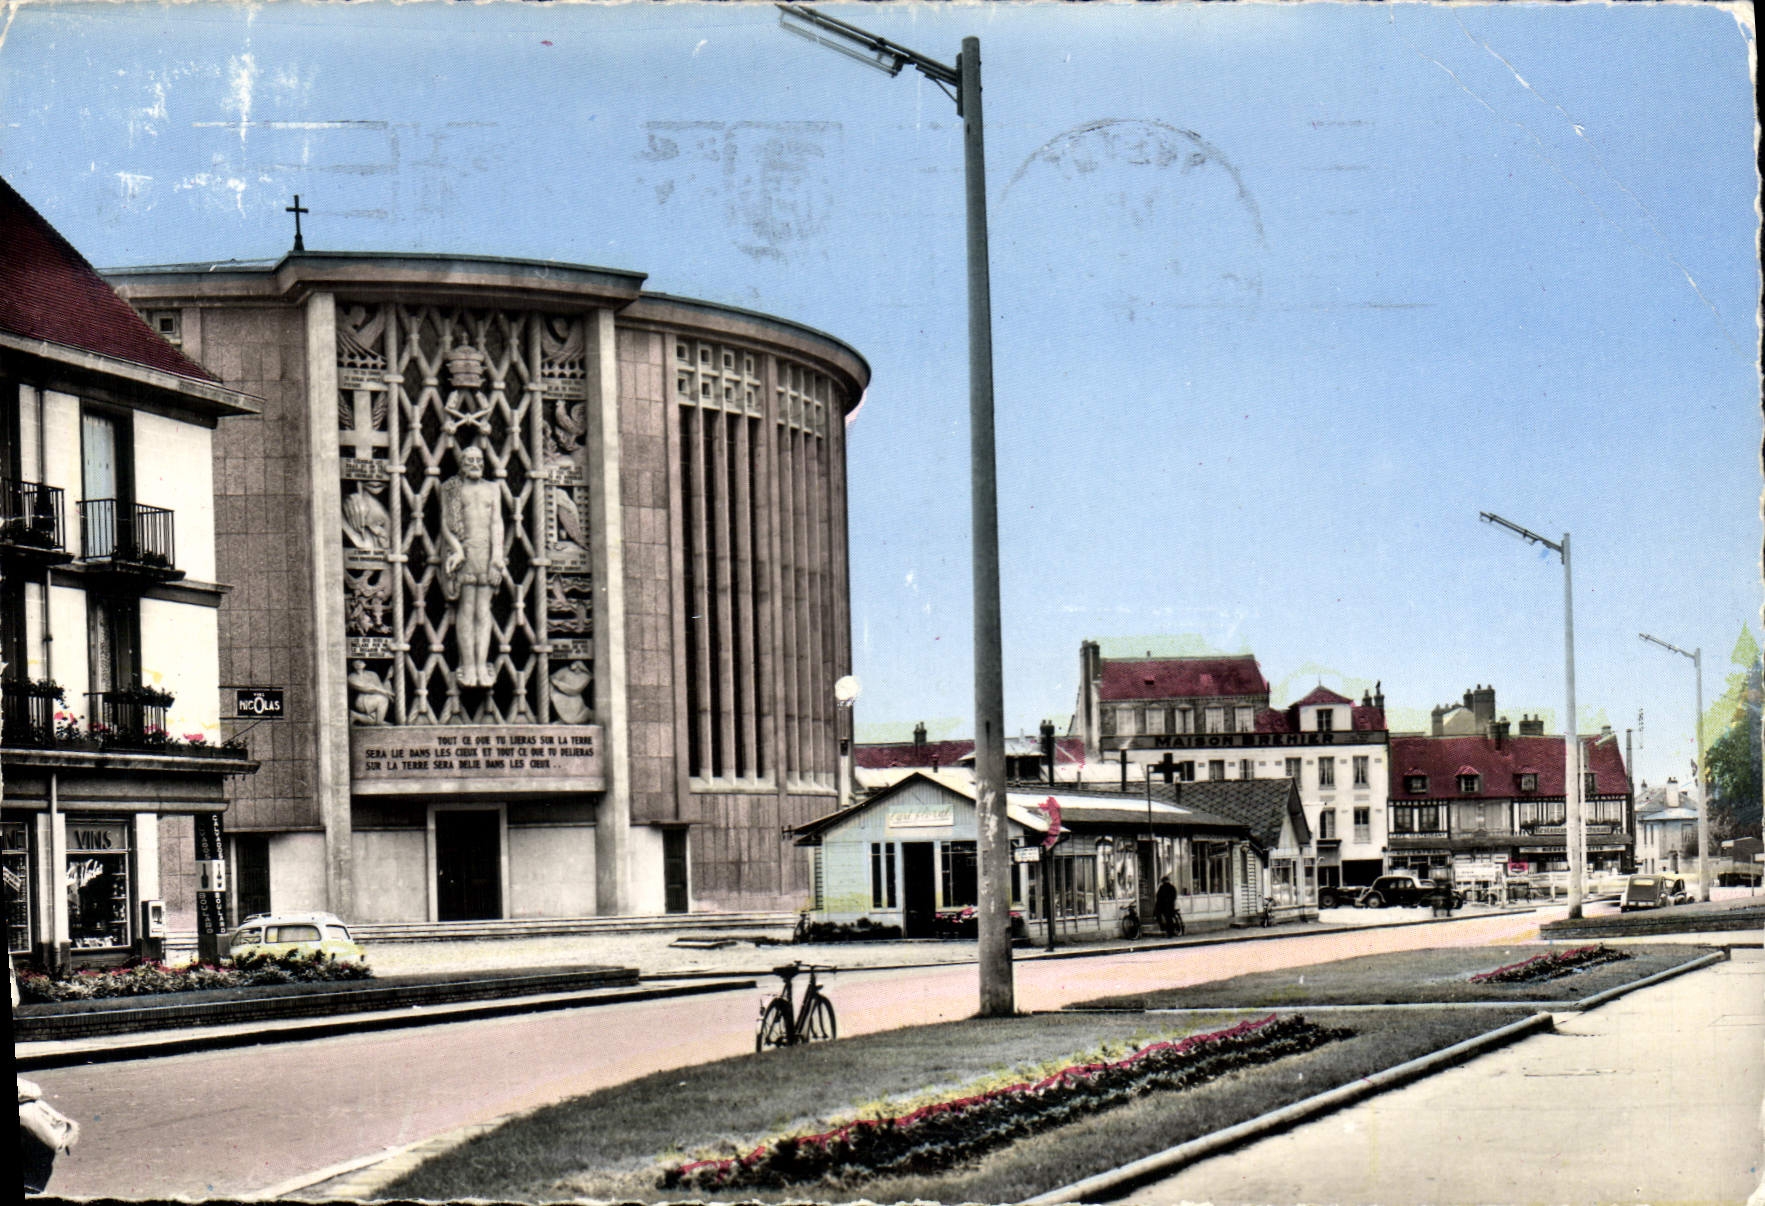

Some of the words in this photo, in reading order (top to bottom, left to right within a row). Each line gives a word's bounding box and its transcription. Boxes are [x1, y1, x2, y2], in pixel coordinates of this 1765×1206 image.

[239, 696, 280, 714] NICOLAS
[437, 736, 457, 745] TOUT
[462, 736, 472, 745] CE
[496, 736, 506, 744] TU
[510, 736, 536, 744] LIERAS
[540, 736, 555, 744] SUR
[558, 736, 568, 744] LA
[571, 736, 593, 744] TERRE
[1154, 735, 1234, 747] MAISON
[365, 749, 387, 759] SERA
[409, 748, 430, 758] DANS
[435, 748, 452, 757] LES
[482, 748, 492, 757] ET
[497, 748, 515, 756] TOUT
[518, 748, 528, 756] CE
[548, 748, 557, 756] TU
[365, 761, 381, 771] SUR
[387, 762, 398, 770] LA
[402, 761, 429, 770] TERRE
[433, 761, 454, 770] SERA
[485, 760, 505, 769] DANS
[510, 760, 525, 769] LES
[74, 830, 112, 849] VINS
[212, 814, 224, 860] CALVADOS
